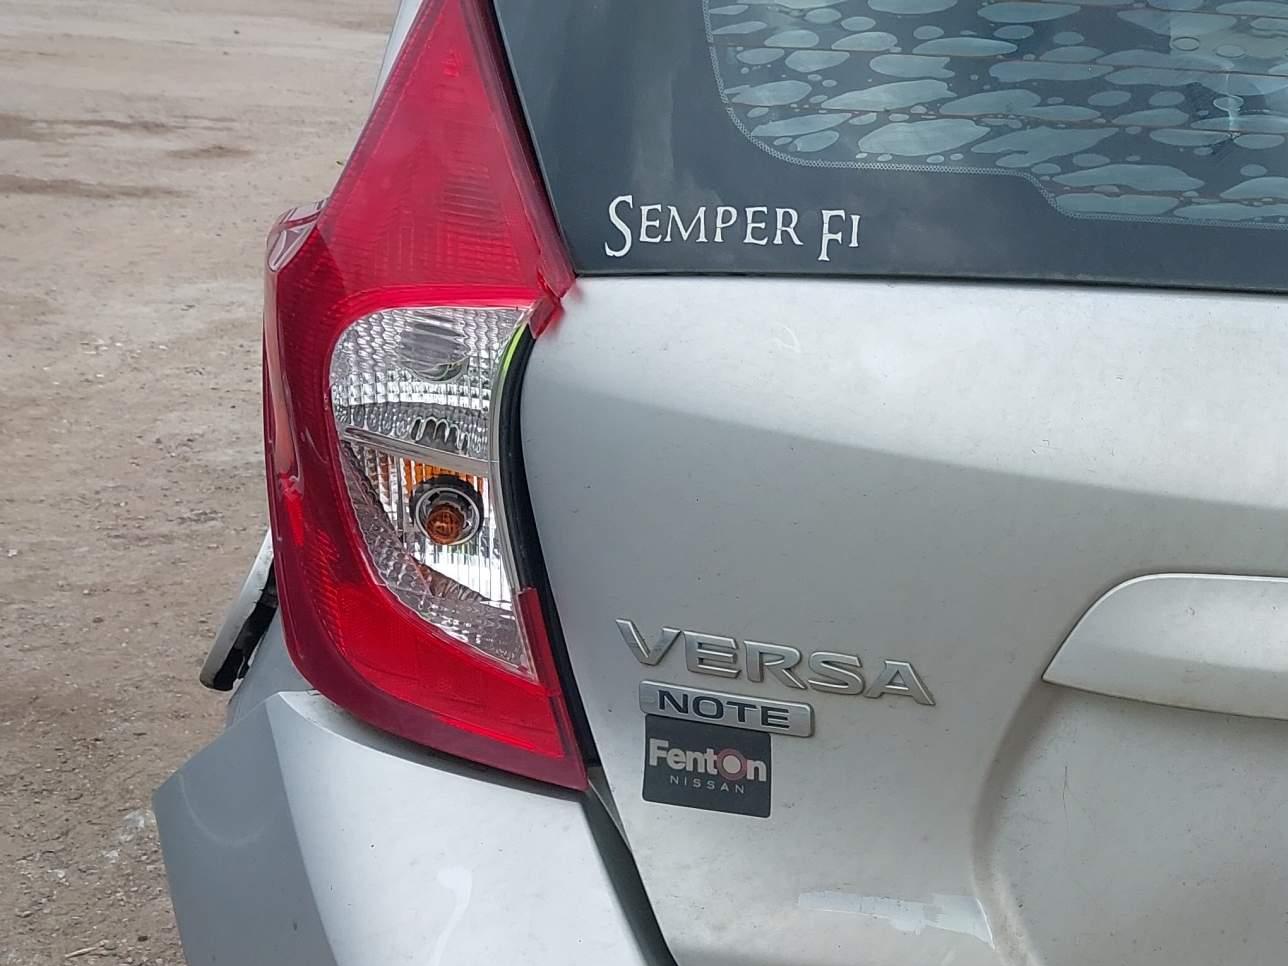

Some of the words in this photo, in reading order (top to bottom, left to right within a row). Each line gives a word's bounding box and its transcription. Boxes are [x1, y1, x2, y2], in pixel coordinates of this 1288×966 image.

[604, 195, 804, 257] SEMPER
[817, 209, 861, 261] FI
[615, 617, 936, 706] VERSA
[657, 689, 791, 729] NOTE
[669, 774, 746, 795] NISSAN
